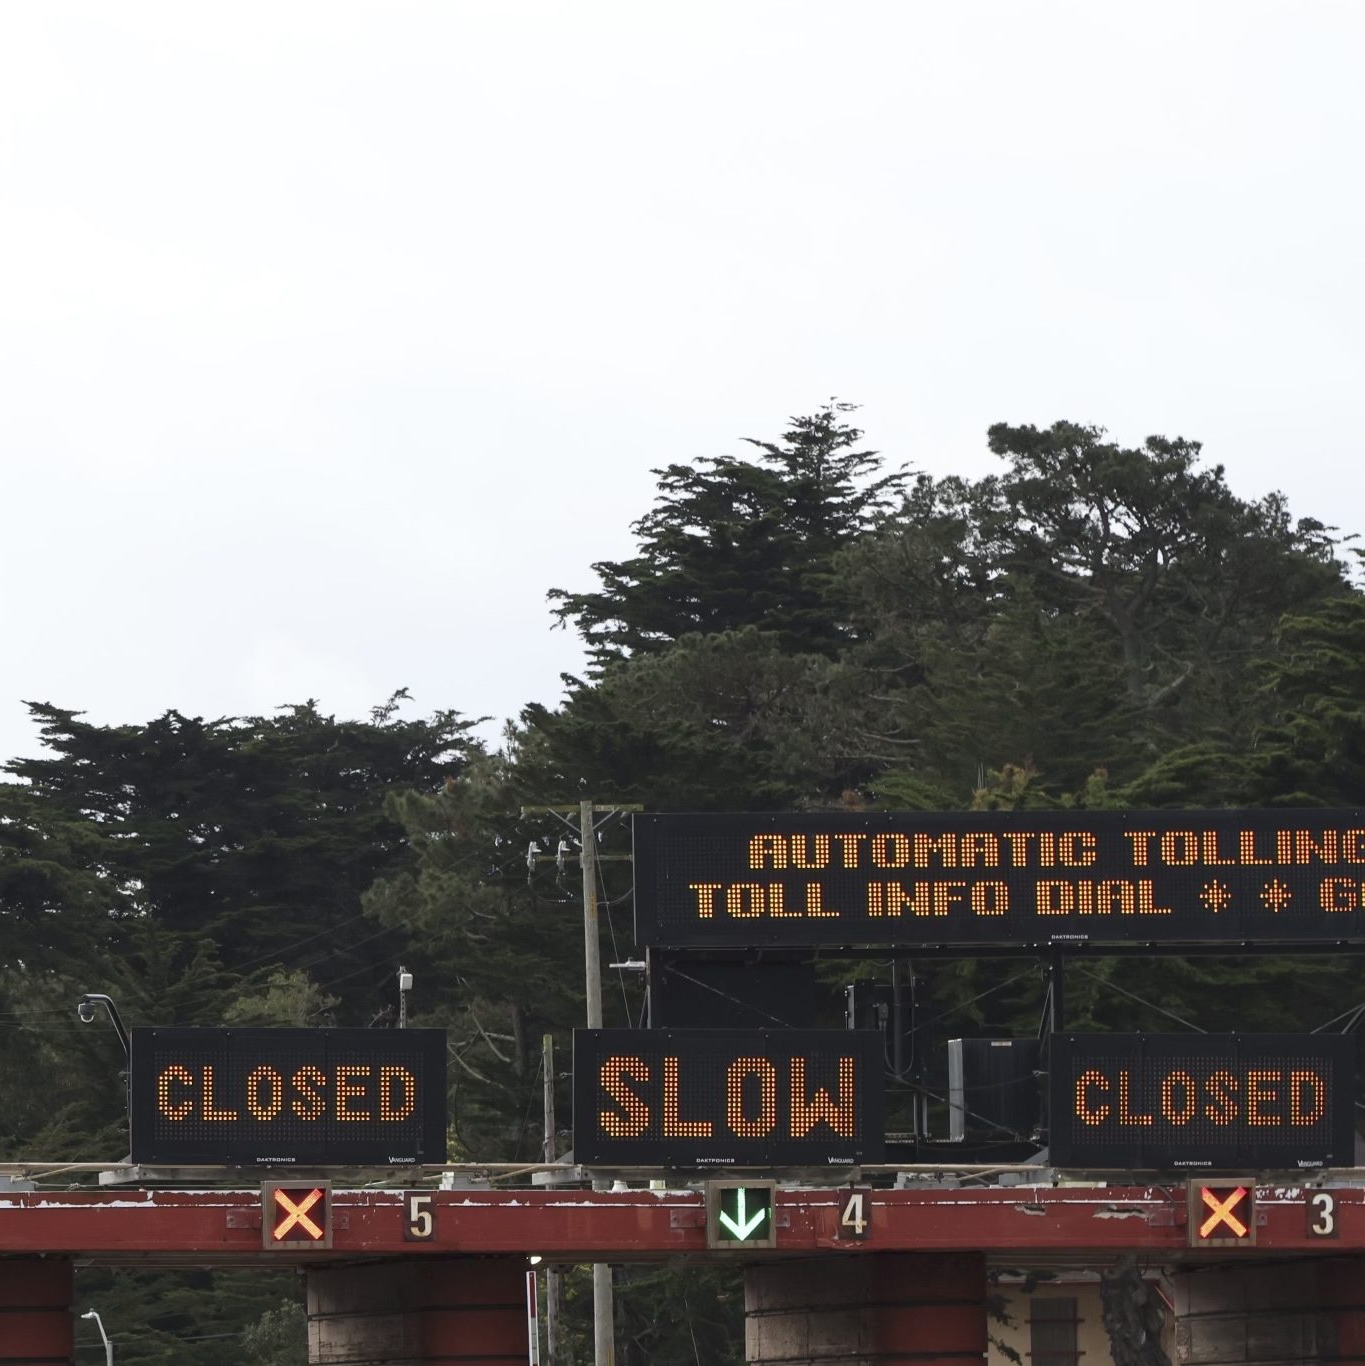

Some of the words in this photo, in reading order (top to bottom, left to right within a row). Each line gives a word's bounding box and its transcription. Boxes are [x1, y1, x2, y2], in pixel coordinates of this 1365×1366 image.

[749, 832, 1096, 869] AUTOMATIC
[1124, 829, 1365, 866] TOLLING
[689, 882, 840, 918] TOLL
[868, 881, 1009, 917] INFO
[1036, 879, 1172, 915] DIAL
[158, 1065, 415, 1122] CLOSED
[599, 1055, 854, 1138] SLOW
[1075, 1069, 1325, 1127] CLOSED
[410, 1196, 433, 1237] 5
[841, 1193, 868, 1235] 4
[1312, 1193, 1334, 1235] 3
